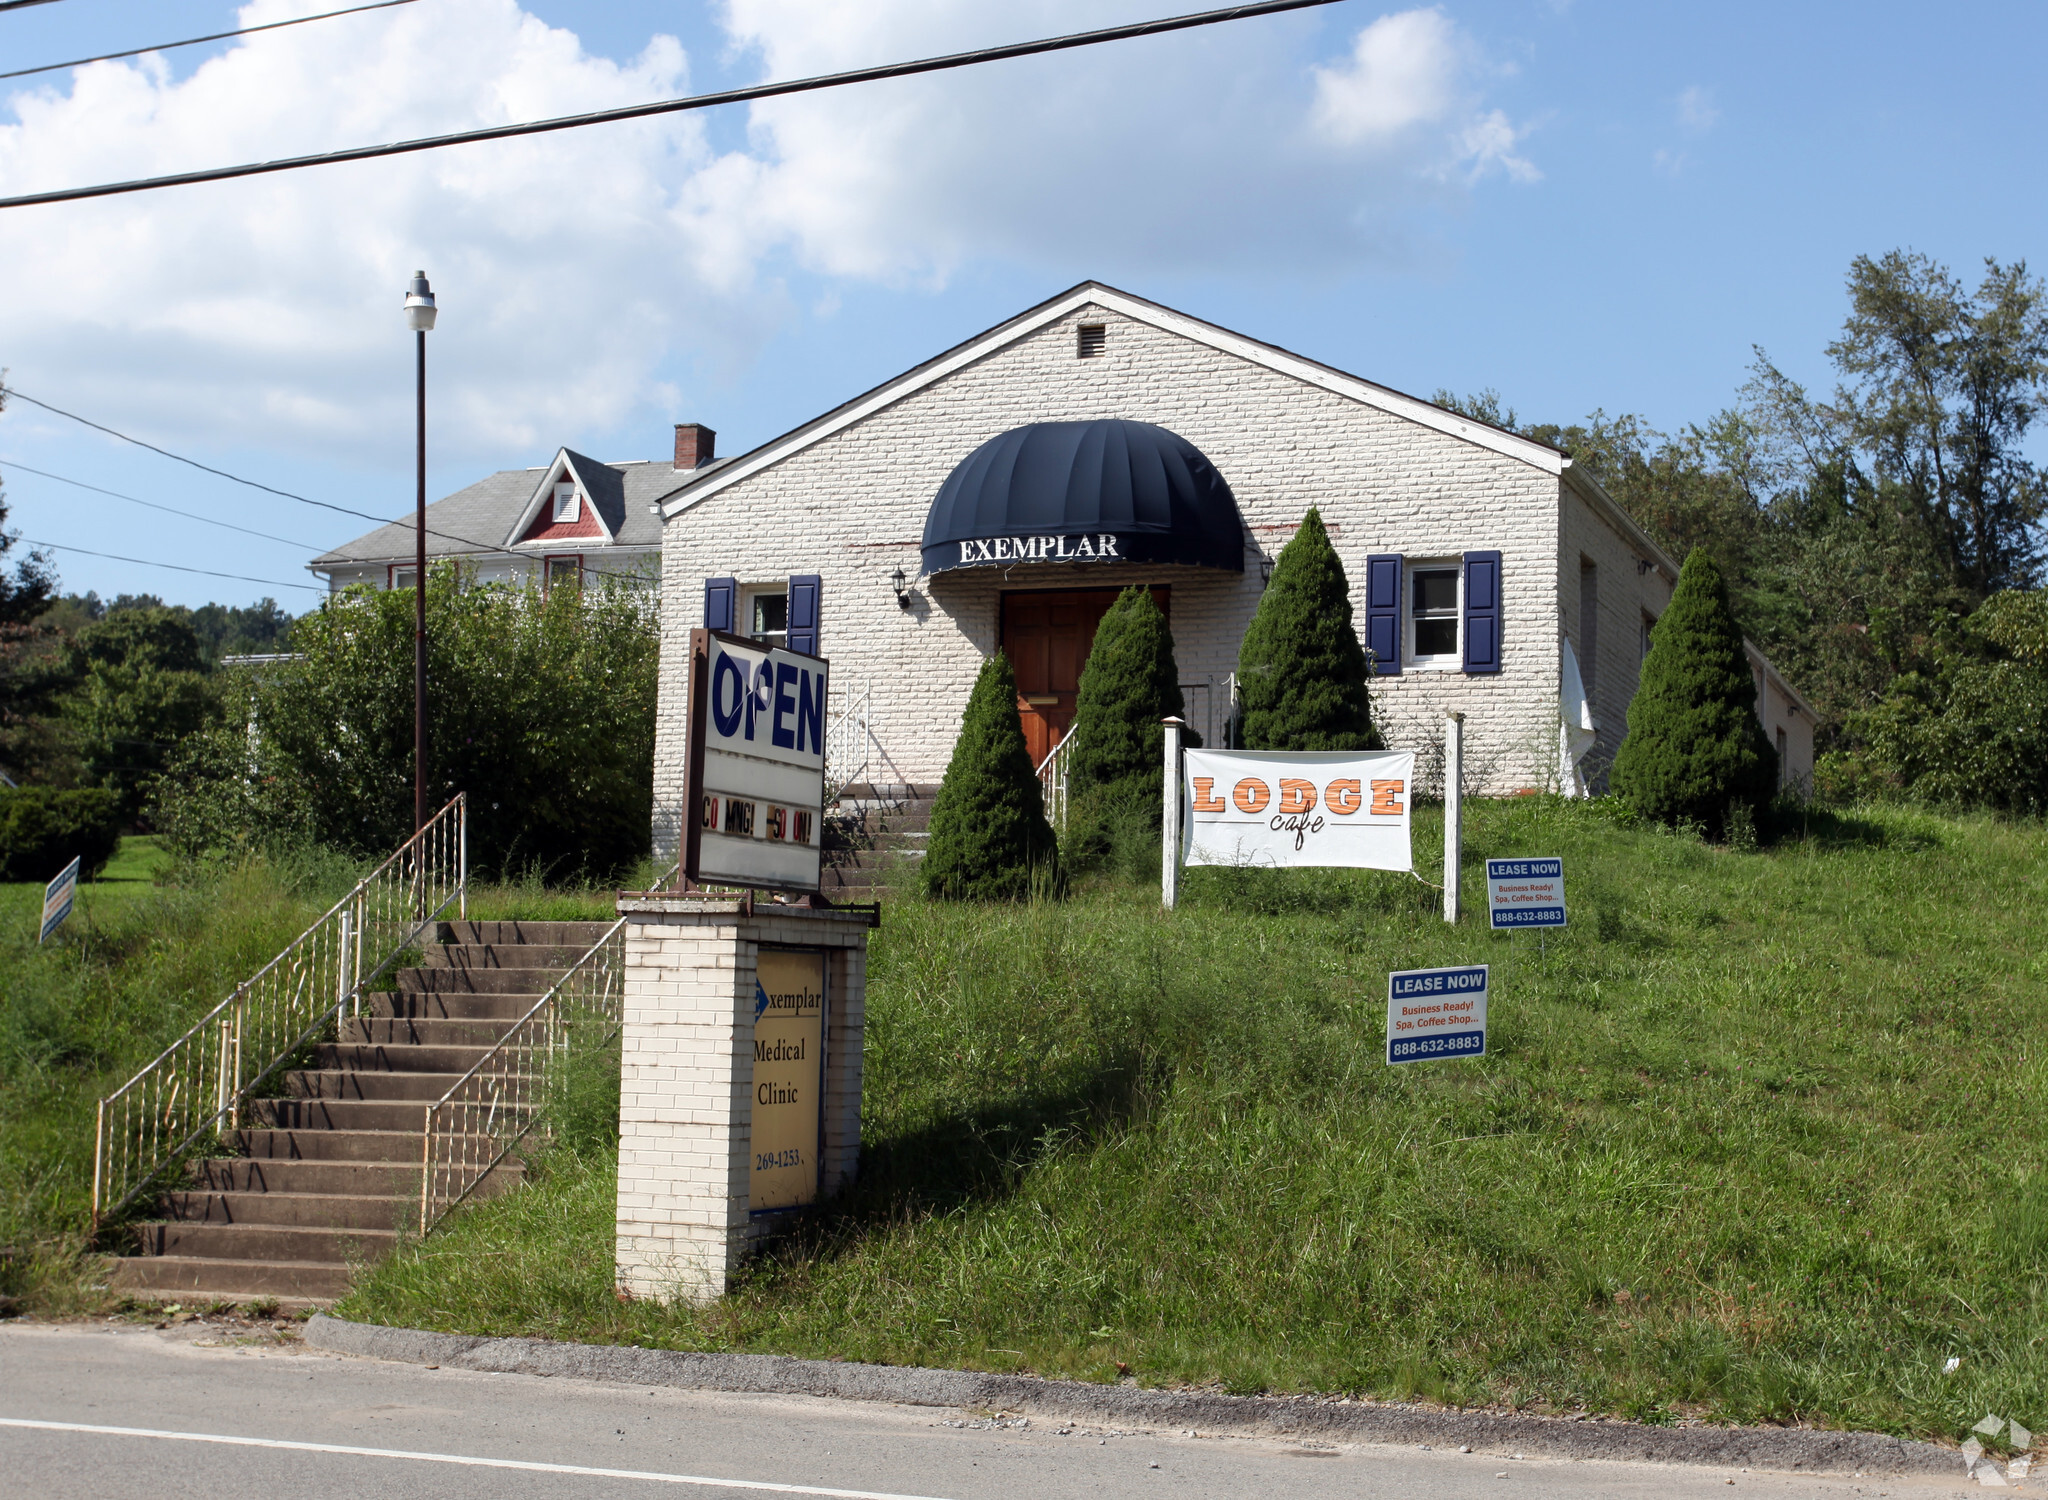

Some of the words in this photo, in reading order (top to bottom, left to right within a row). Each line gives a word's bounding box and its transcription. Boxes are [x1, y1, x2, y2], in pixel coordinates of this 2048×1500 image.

[959, 534, 1119, 563] EXEMPLAR
[712, 650, 824, 756] OPEN
[1192, 777, 1405, 816] LODGE
[1270, 800, 1325, 851] cafe
[1491, 864, 1528, 876] LEASE
[1531, 863, 1558, 875] NOW
[1498, 884, 1528, 893] Business
[1530, 883, 1554, 892] Ready!
[1495, 895, 1510, 904] Spa,
[1511, 894, 1532, 902] Coffee
[1535, 894, 1559, 902] Shop...
[1495, 910, 1561, 922] 888-632-8883
[1395, 977, 1443, 994] LEASE
[1447, 973, 1483, 989] NOW
[1402, 1005, 1441, 1016] Business
[1443, 1001, 1474, 1012] Ready!
[1396, 1020, 1415, 1031] Spa,
[1417, 1017, 1446, 1028] Coffee
[1448, 1015, 1479, 1025] Shop...
[753, 1037, 805, 1063] Medical
[1393, 1036, 1480, 1056] 888-632-8883
[758, 1081, 798, 1106] Clinic
[756, 1149, 800, 1171] 269-1253
